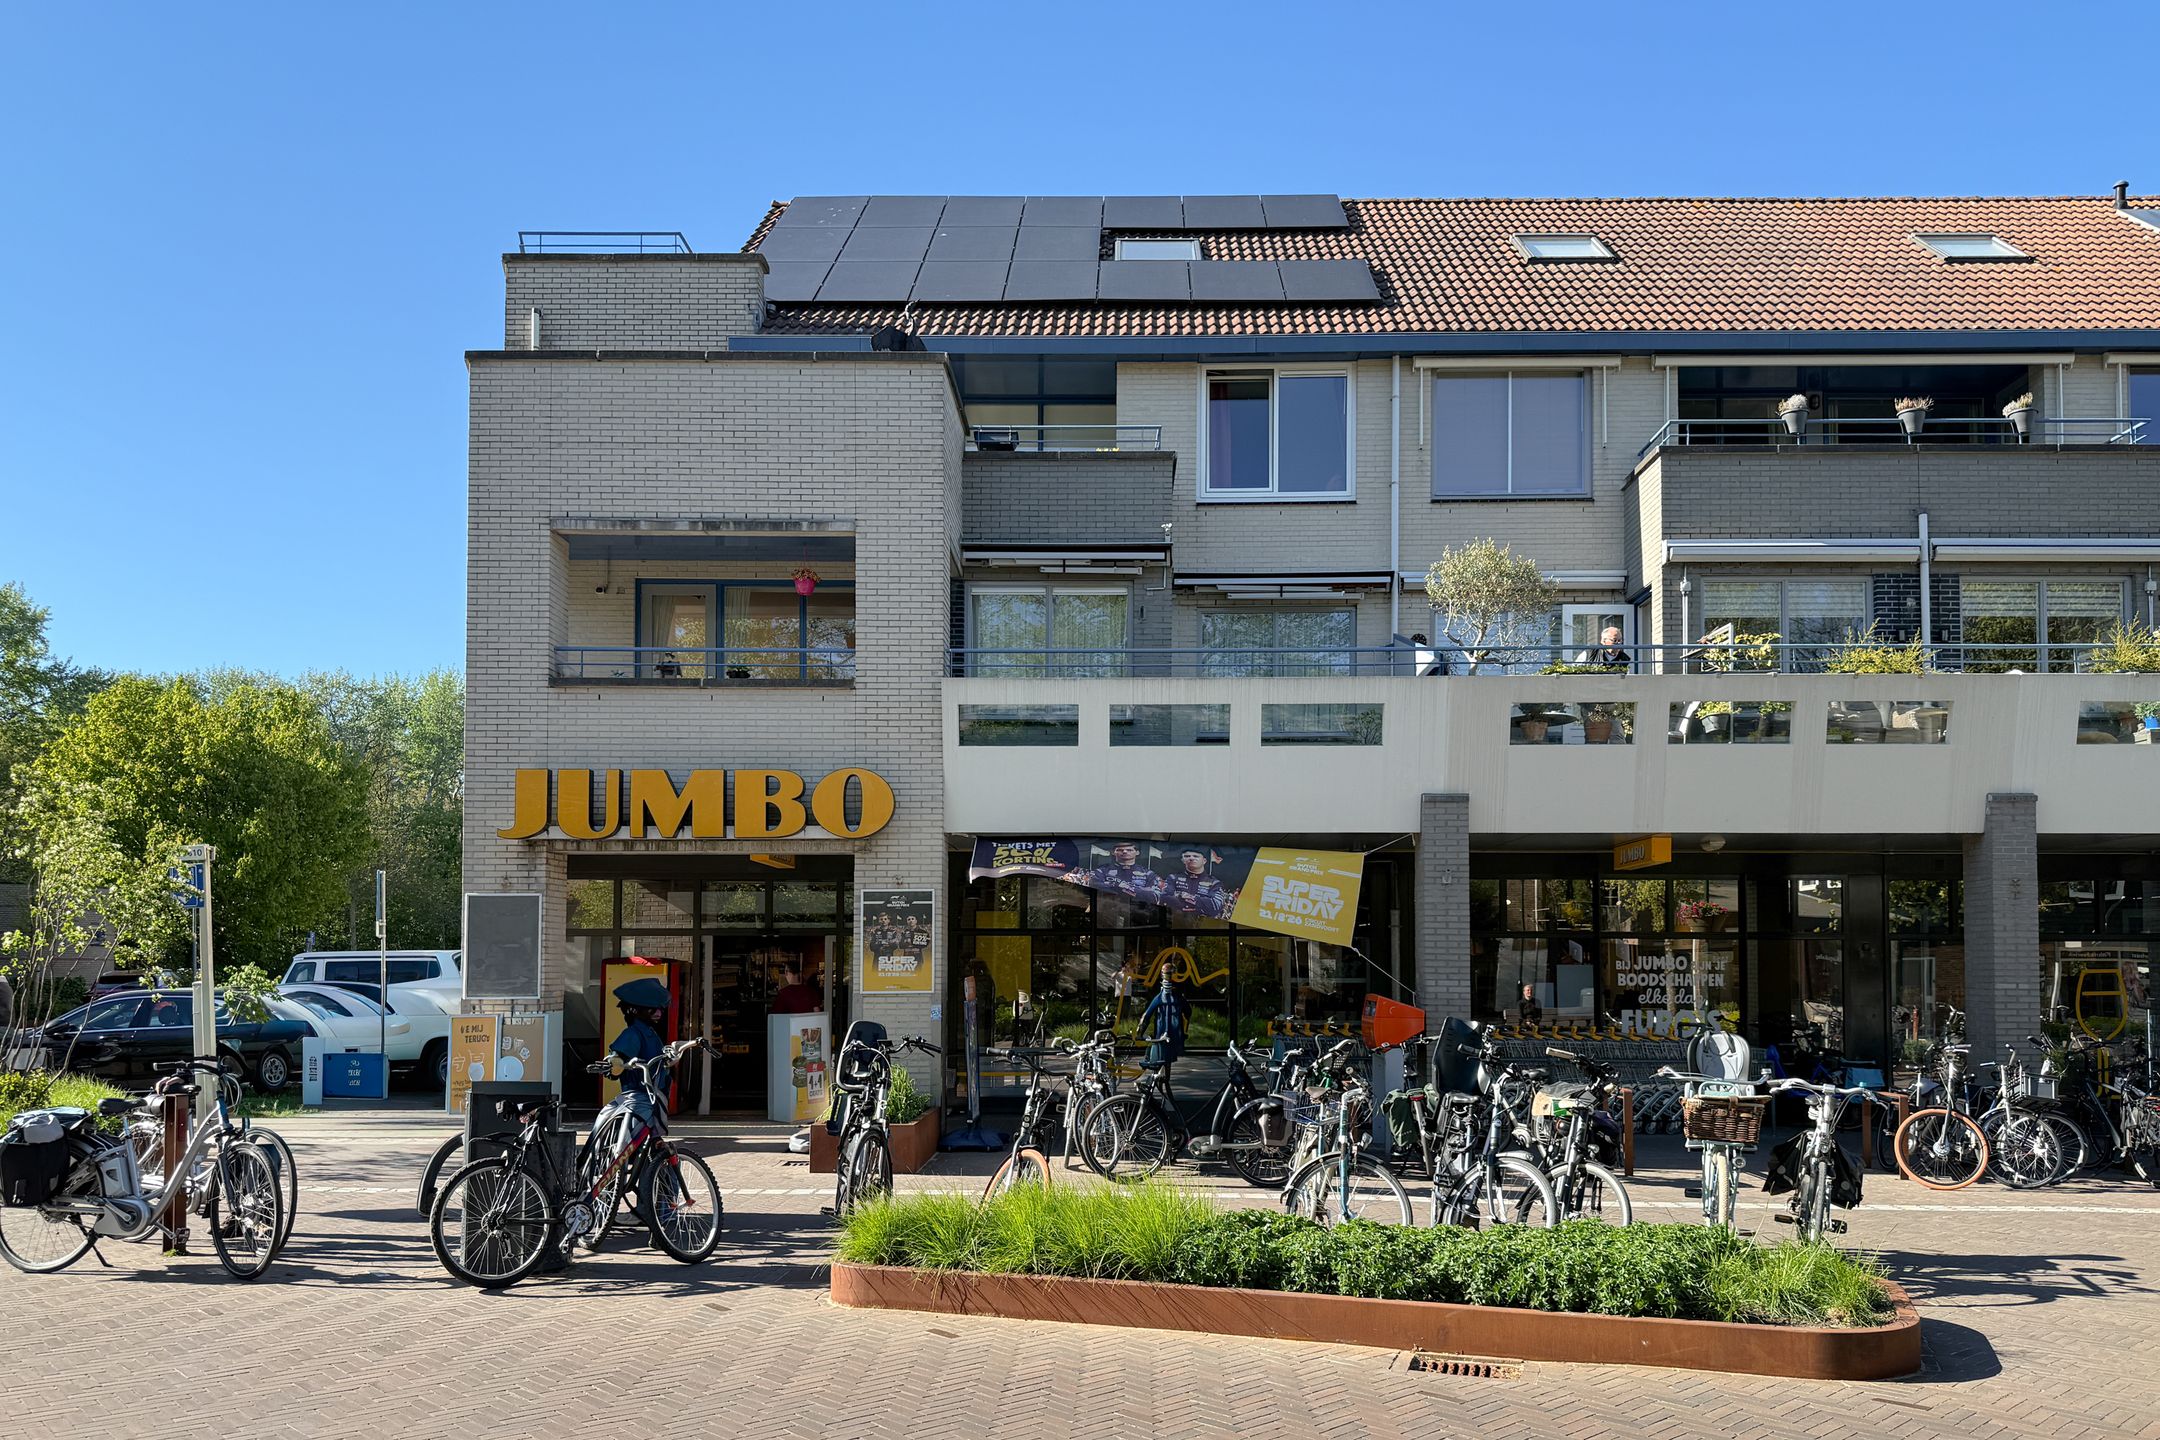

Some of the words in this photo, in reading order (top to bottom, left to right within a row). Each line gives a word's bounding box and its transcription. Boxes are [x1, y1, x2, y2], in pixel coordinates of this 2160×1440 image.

[497, 767, 896, 840] JUMBO
[992, 842, 1033, 850] TKETS
[995, 847, 1053, 859] 50%
[1620, 843, 1645, 865] JUMBO
[1263, 875, 1345, 905] SUPER
[1260, 891, 1343, 920] FRIDAY
[878, 963, 917, 971] FRIDAY
[1616, 960, 1630, 970] BIJ
[1634, 955, 1688, 970] JUMBO
[1714, 960, 1726, 970] JE
[1638, 988, 1668, 1004] elke
